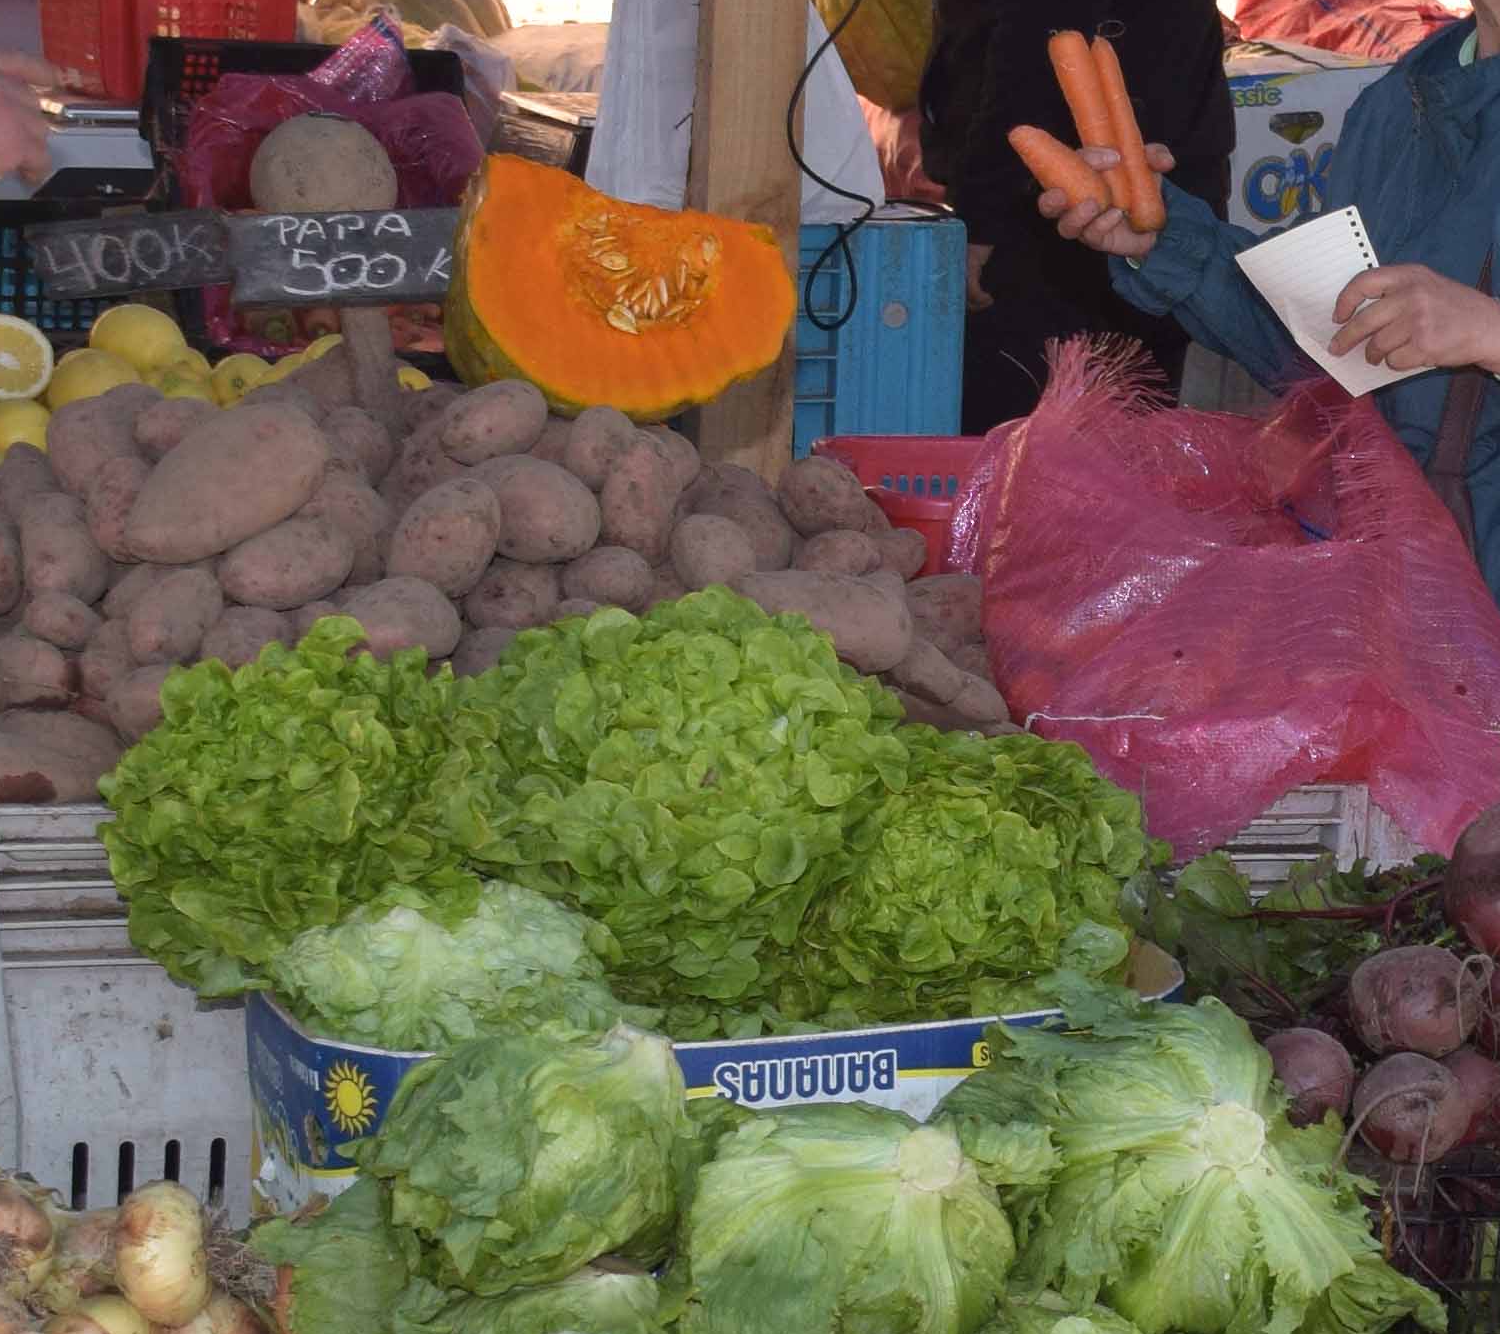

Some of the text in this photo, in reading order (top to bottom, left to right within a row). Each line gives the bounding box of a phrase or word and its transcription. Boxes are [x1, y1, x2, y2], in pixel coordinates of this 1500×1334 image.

[262, 213, 412, 247] PAPA
[284, 248, 407, 295] 500
[714, 1049, 897, 1102] BANANAS
